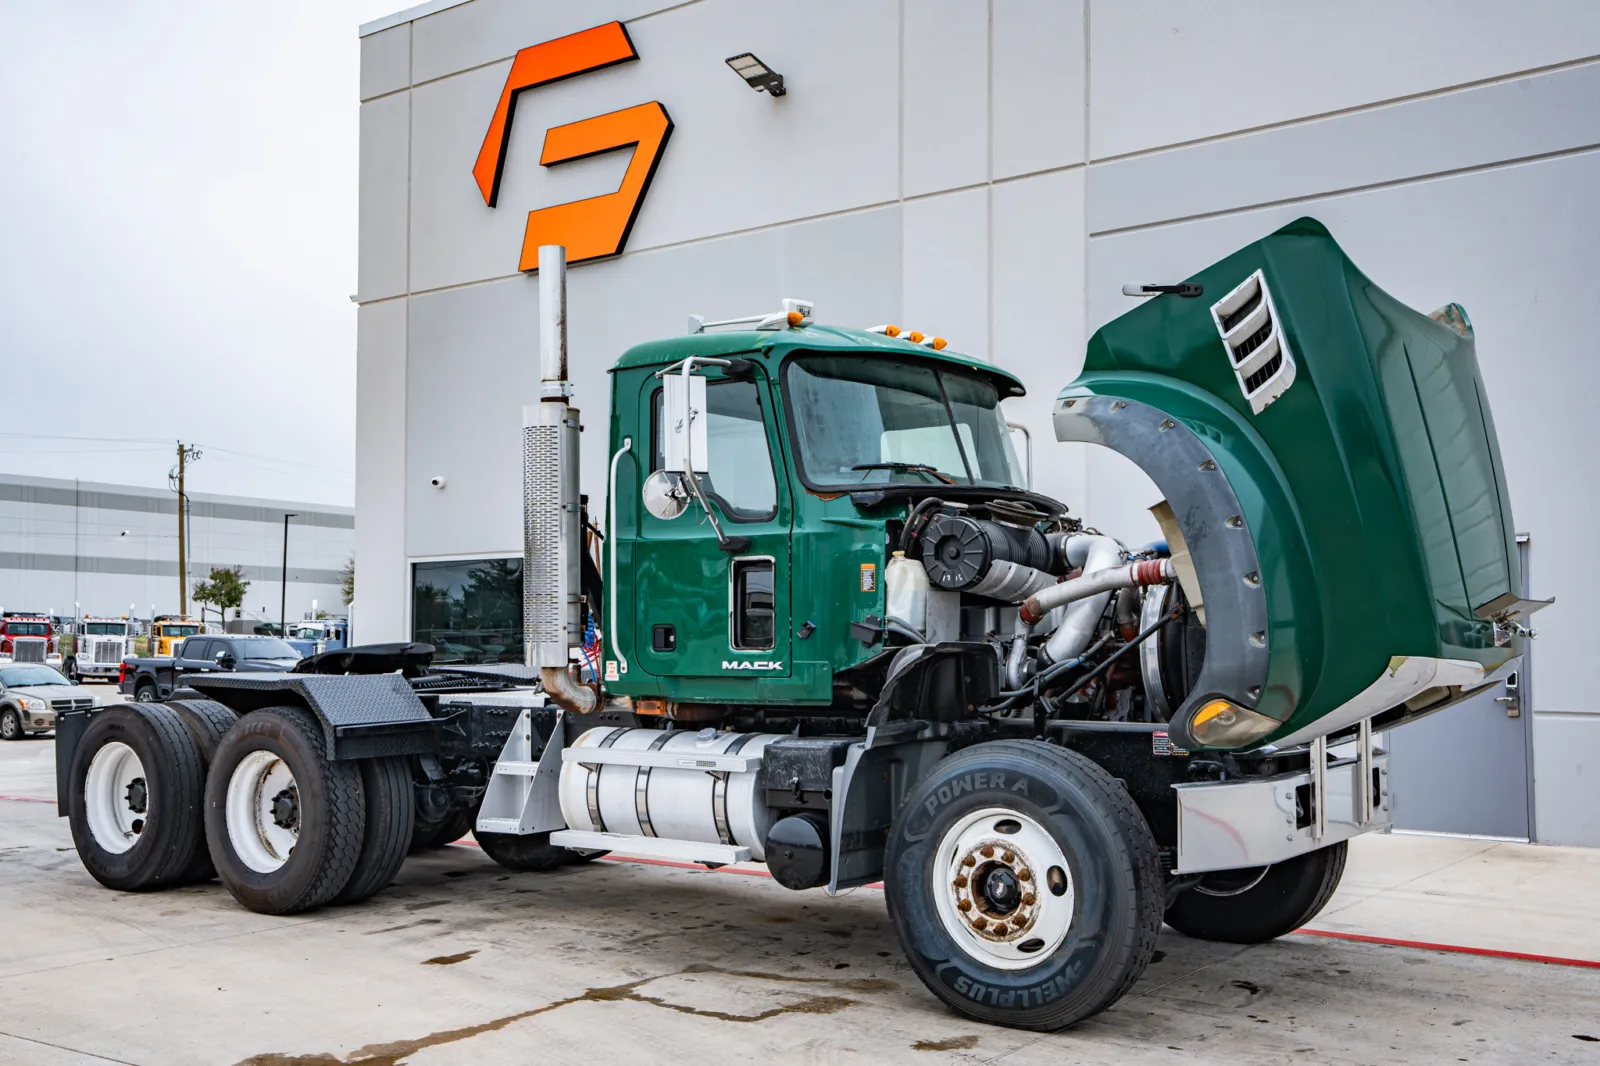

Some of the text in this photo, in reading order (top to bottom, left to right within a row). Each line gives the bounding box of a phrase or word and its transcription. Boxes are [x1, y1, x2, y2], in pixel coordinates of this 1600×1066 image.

[721, 660, 784, 670] MACK
[924, 772, 1006, 817] POWER
[953, 959, 1084, 1008] WELLPLUS
